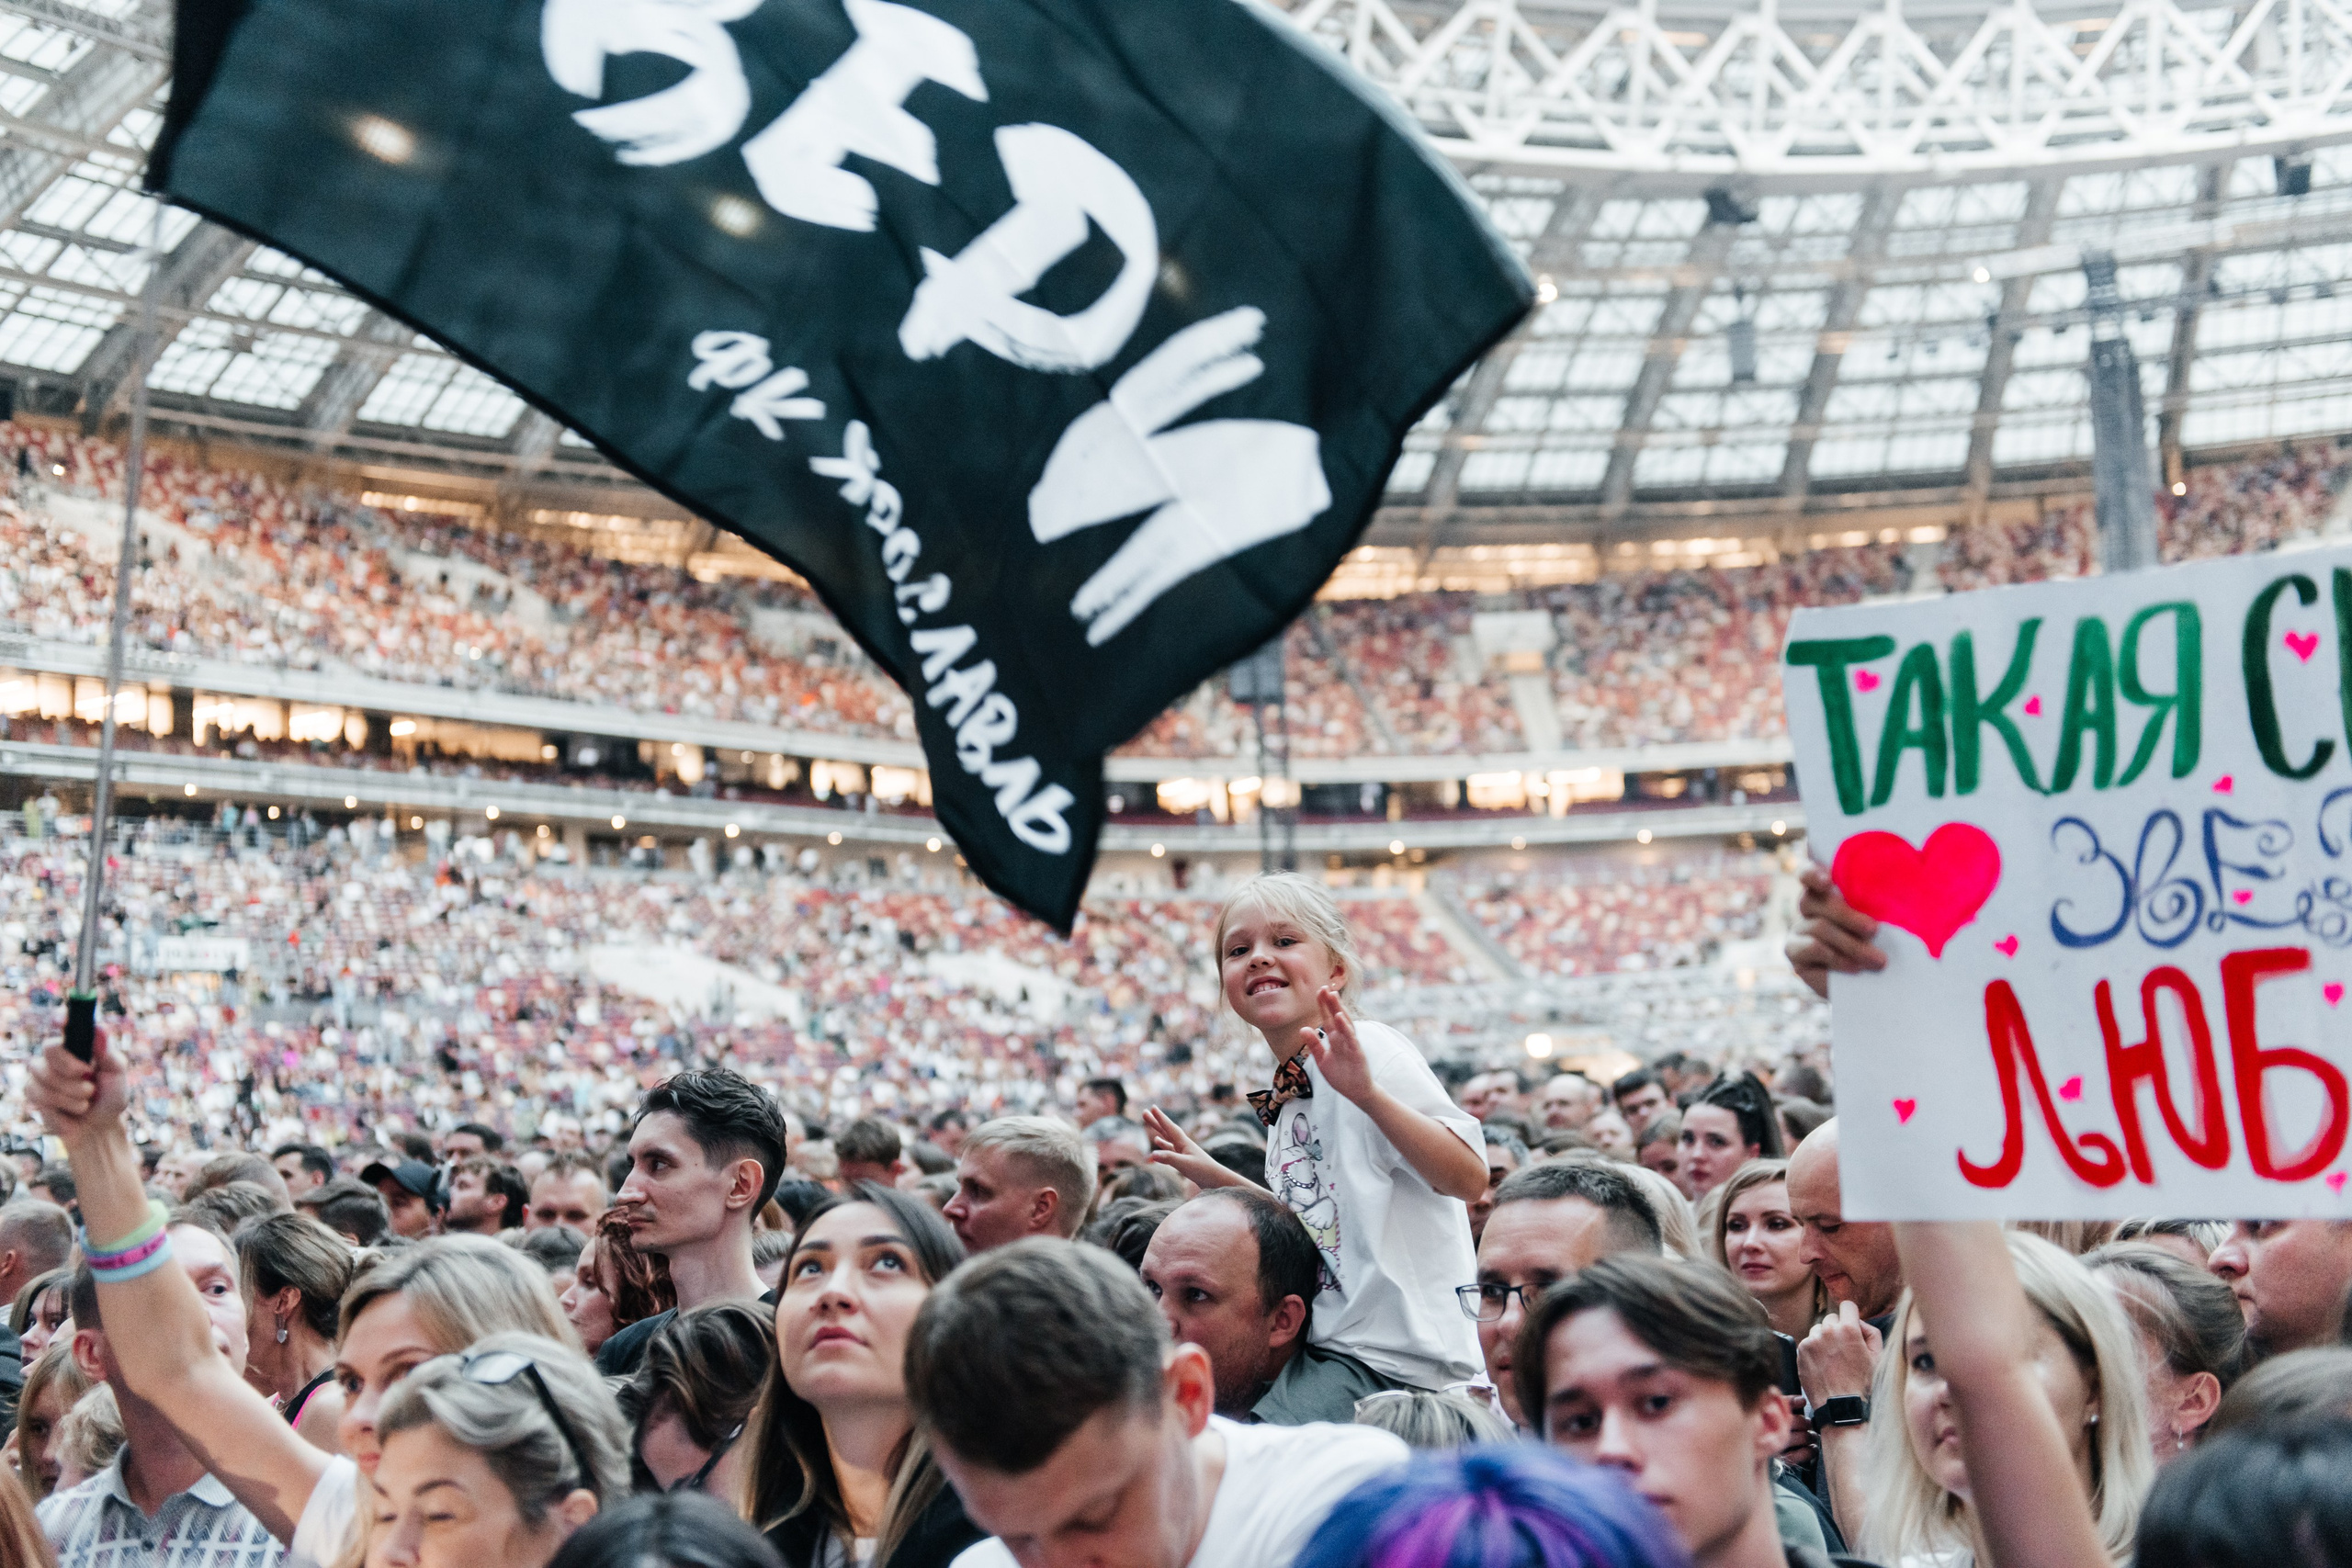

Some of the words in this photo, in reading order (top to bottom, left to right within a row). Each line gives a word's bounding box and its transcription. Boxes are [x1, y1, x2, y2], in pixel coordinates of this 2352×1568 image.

[687, 330, 826, 441] ФК
[1786, 600, 2203, 817] ТАКАЯ
[1958, 947, 2349, 1190] ЛЮБ
